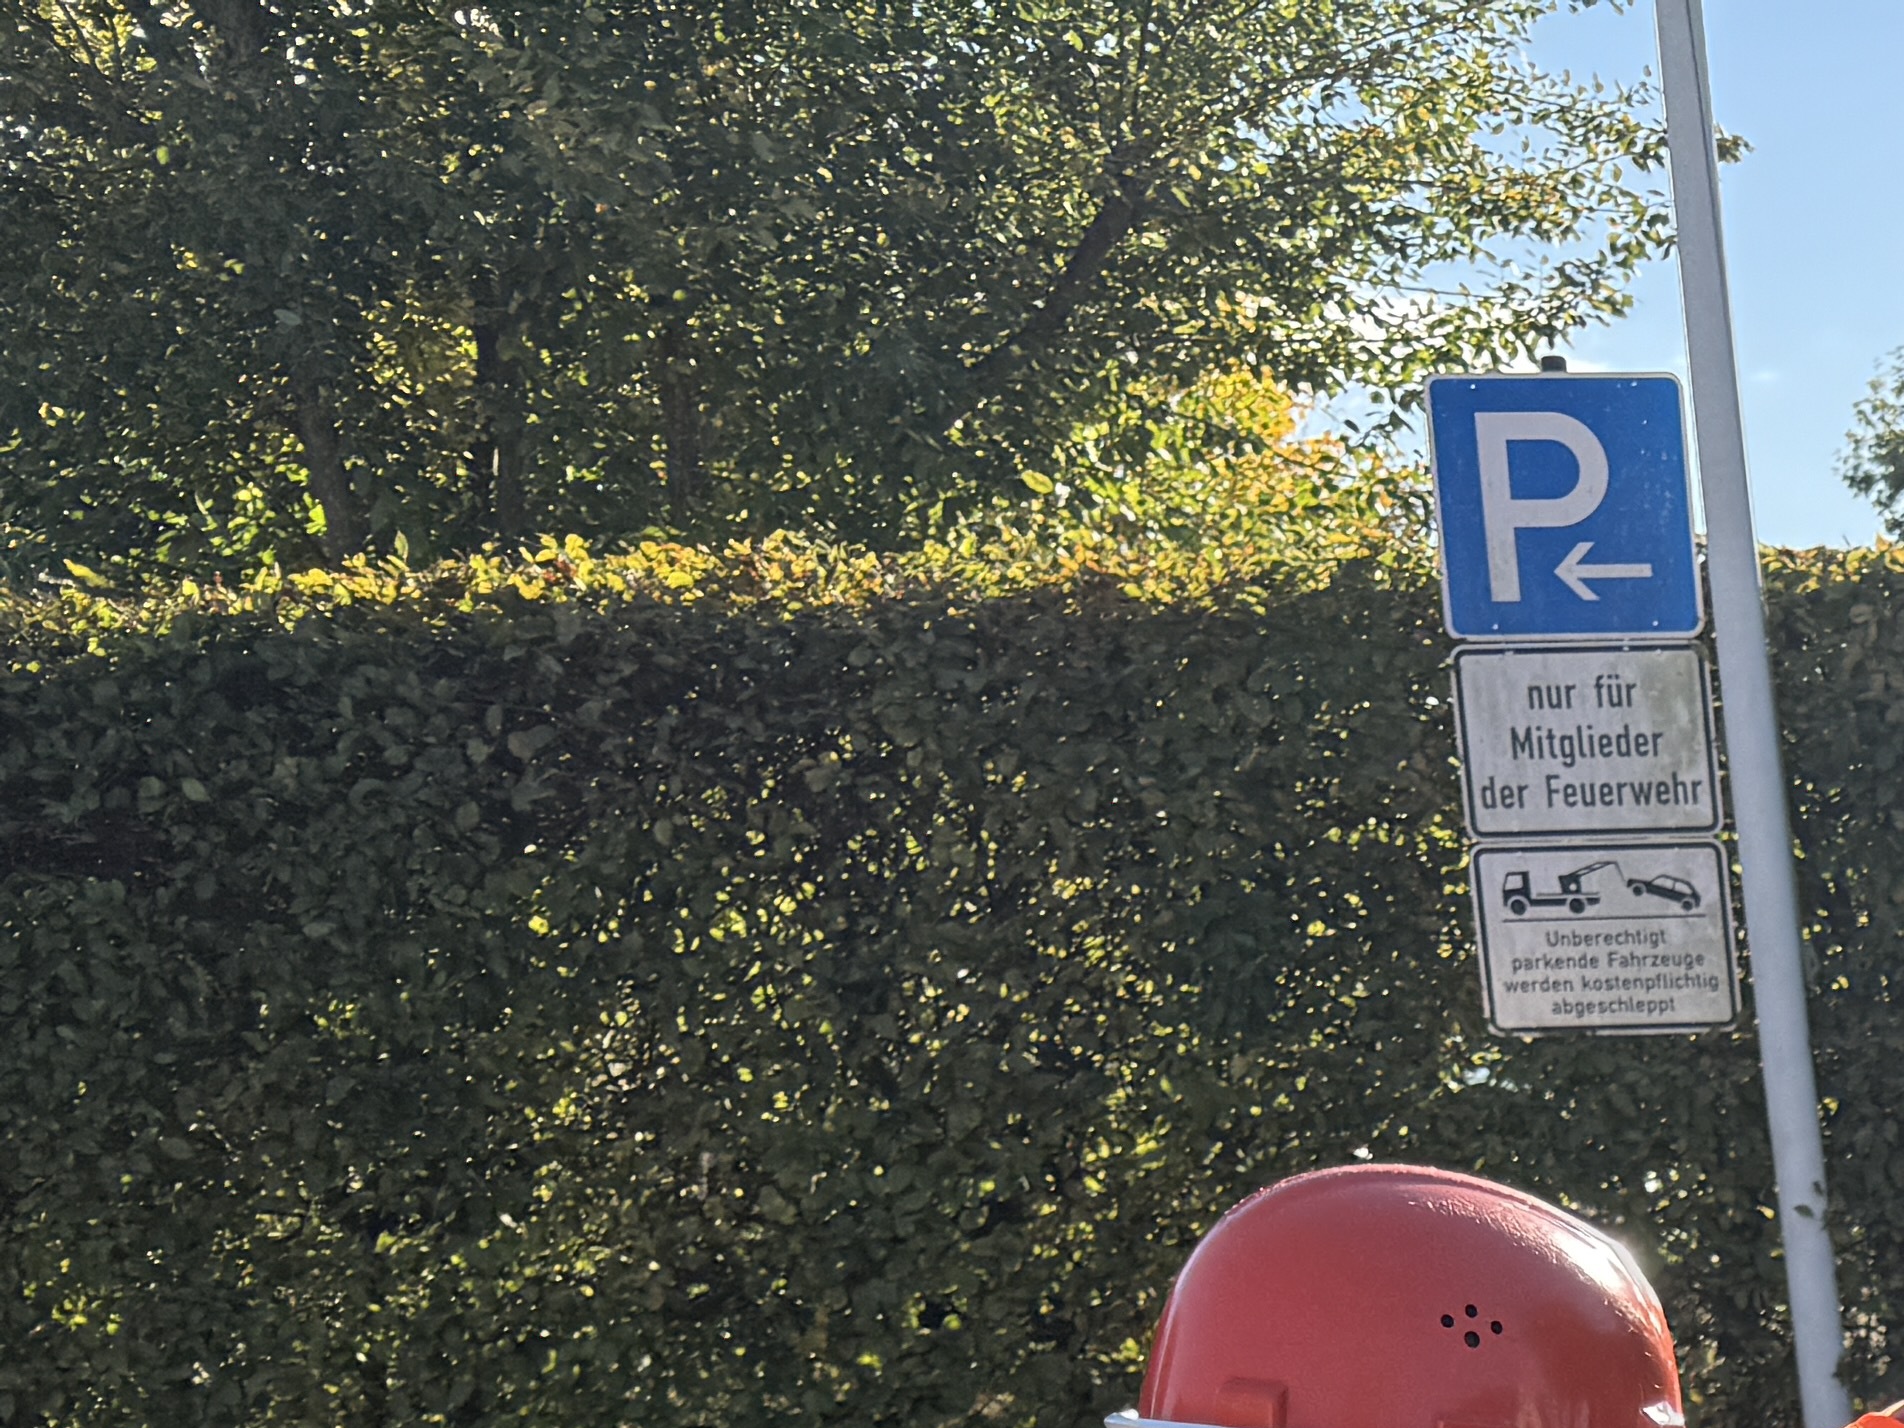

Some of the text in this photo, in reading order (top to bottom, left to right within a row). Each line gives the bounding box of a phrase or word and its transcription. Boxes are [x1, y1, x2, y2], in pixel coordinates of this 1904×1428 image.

[1473, 411, 1610, 603] P
[1527, 674, 1637, 710] nur für
[1509, 723, 1664, 768] Mitglieder
[1480, 771, 1703, 810] der Feuerwehr
[1545, 929, 1667, 949] Unberechtigt
[1511, 951, 1706, 974] parkende Fahrzeuge
[1503, 973, 1720, 993] werden kostenpflichtig
[1551, 997, 1676, 1018] abgeschleppt
